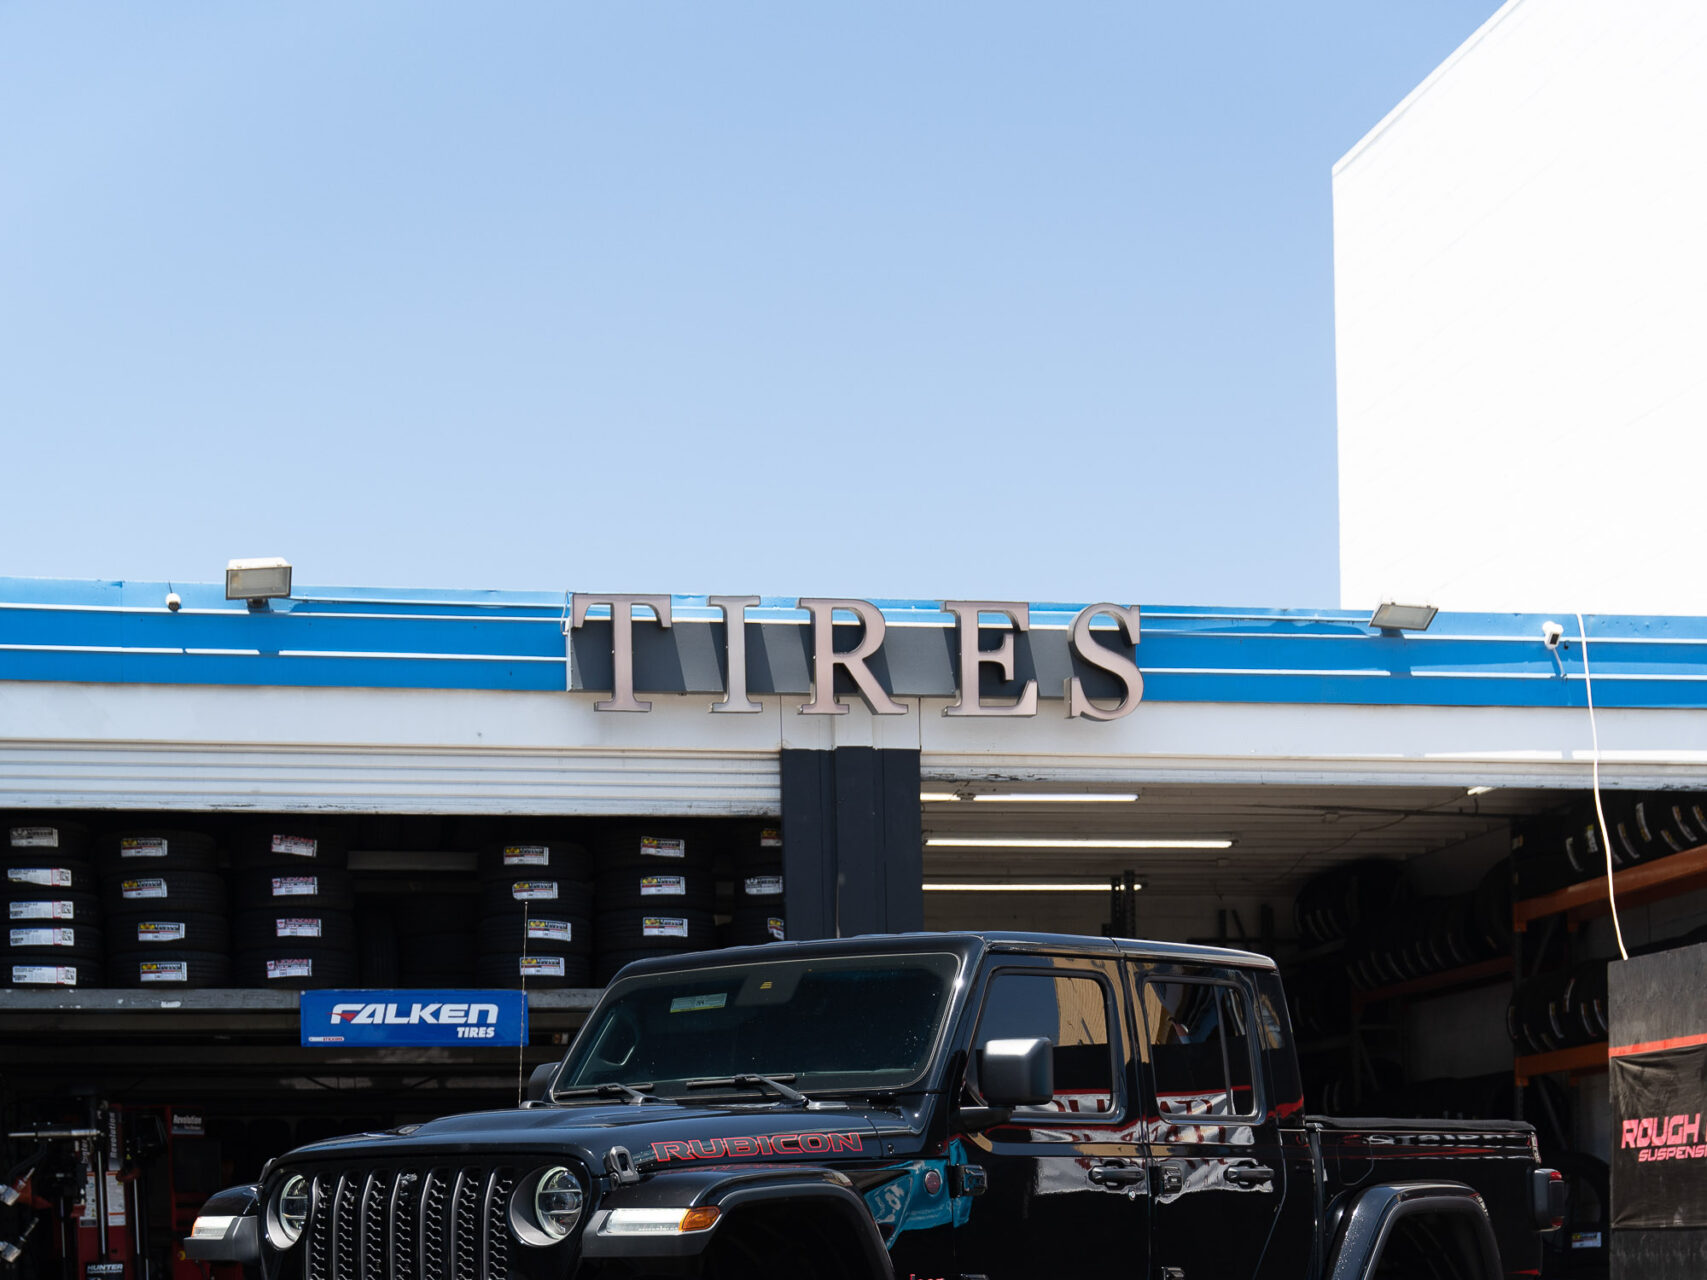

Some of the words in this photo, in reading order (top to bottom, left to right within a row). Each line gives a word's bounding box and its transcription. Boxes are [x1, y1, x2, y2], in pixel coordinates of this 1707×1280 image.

[571, 594, 1144, 721] TIRES
[330, 1003, 499, 1024] FALKEN
[457, 1027, 495, 1038] TIRES
[1621, 1113, 1701, 1149] ROUGH
[651, 1132, 863, 1162] RUBICON
[87, 1263, 123, 1271] HUNTER
